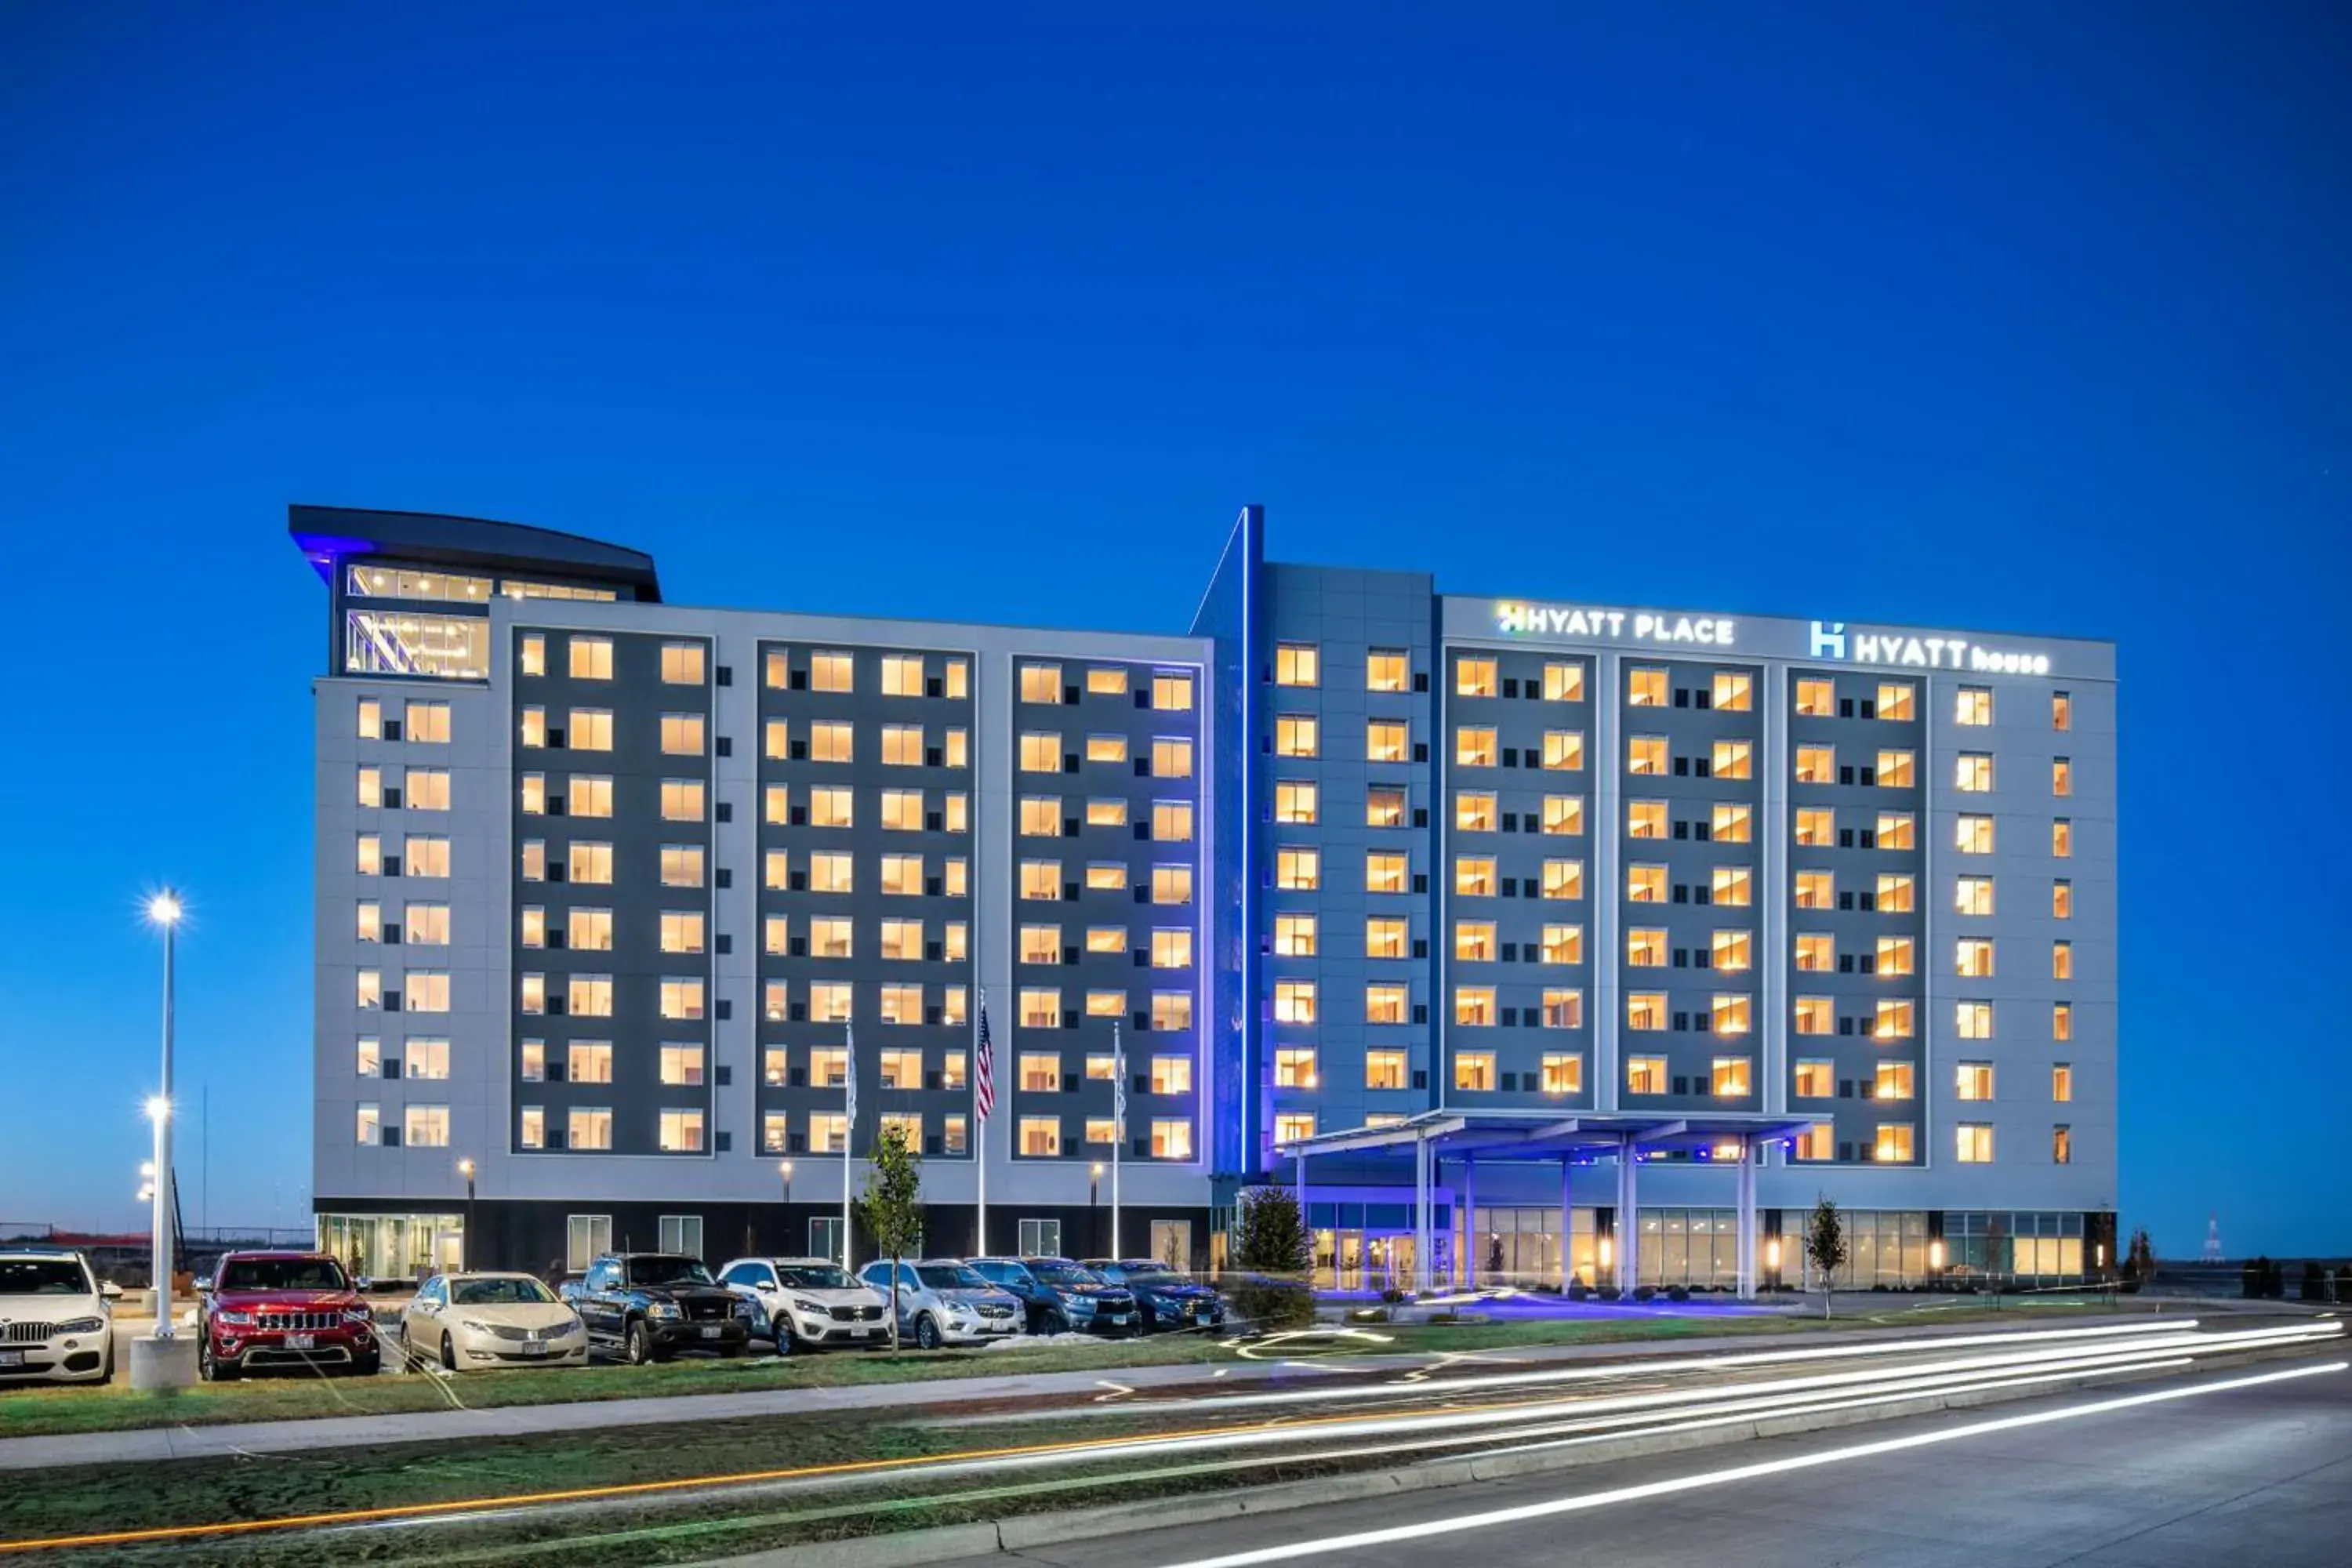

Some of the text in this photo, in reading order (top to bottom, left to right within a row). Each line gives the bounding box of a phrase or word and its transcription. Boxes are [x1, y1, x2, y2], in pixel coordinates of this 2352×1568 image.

[1528, 608, 1625, 637] HYATT
[1635, 615, 1734, 645] PLACE
[1856, 633, 1967, 667] HYATT
[1972, 646, 2049, 675] house
